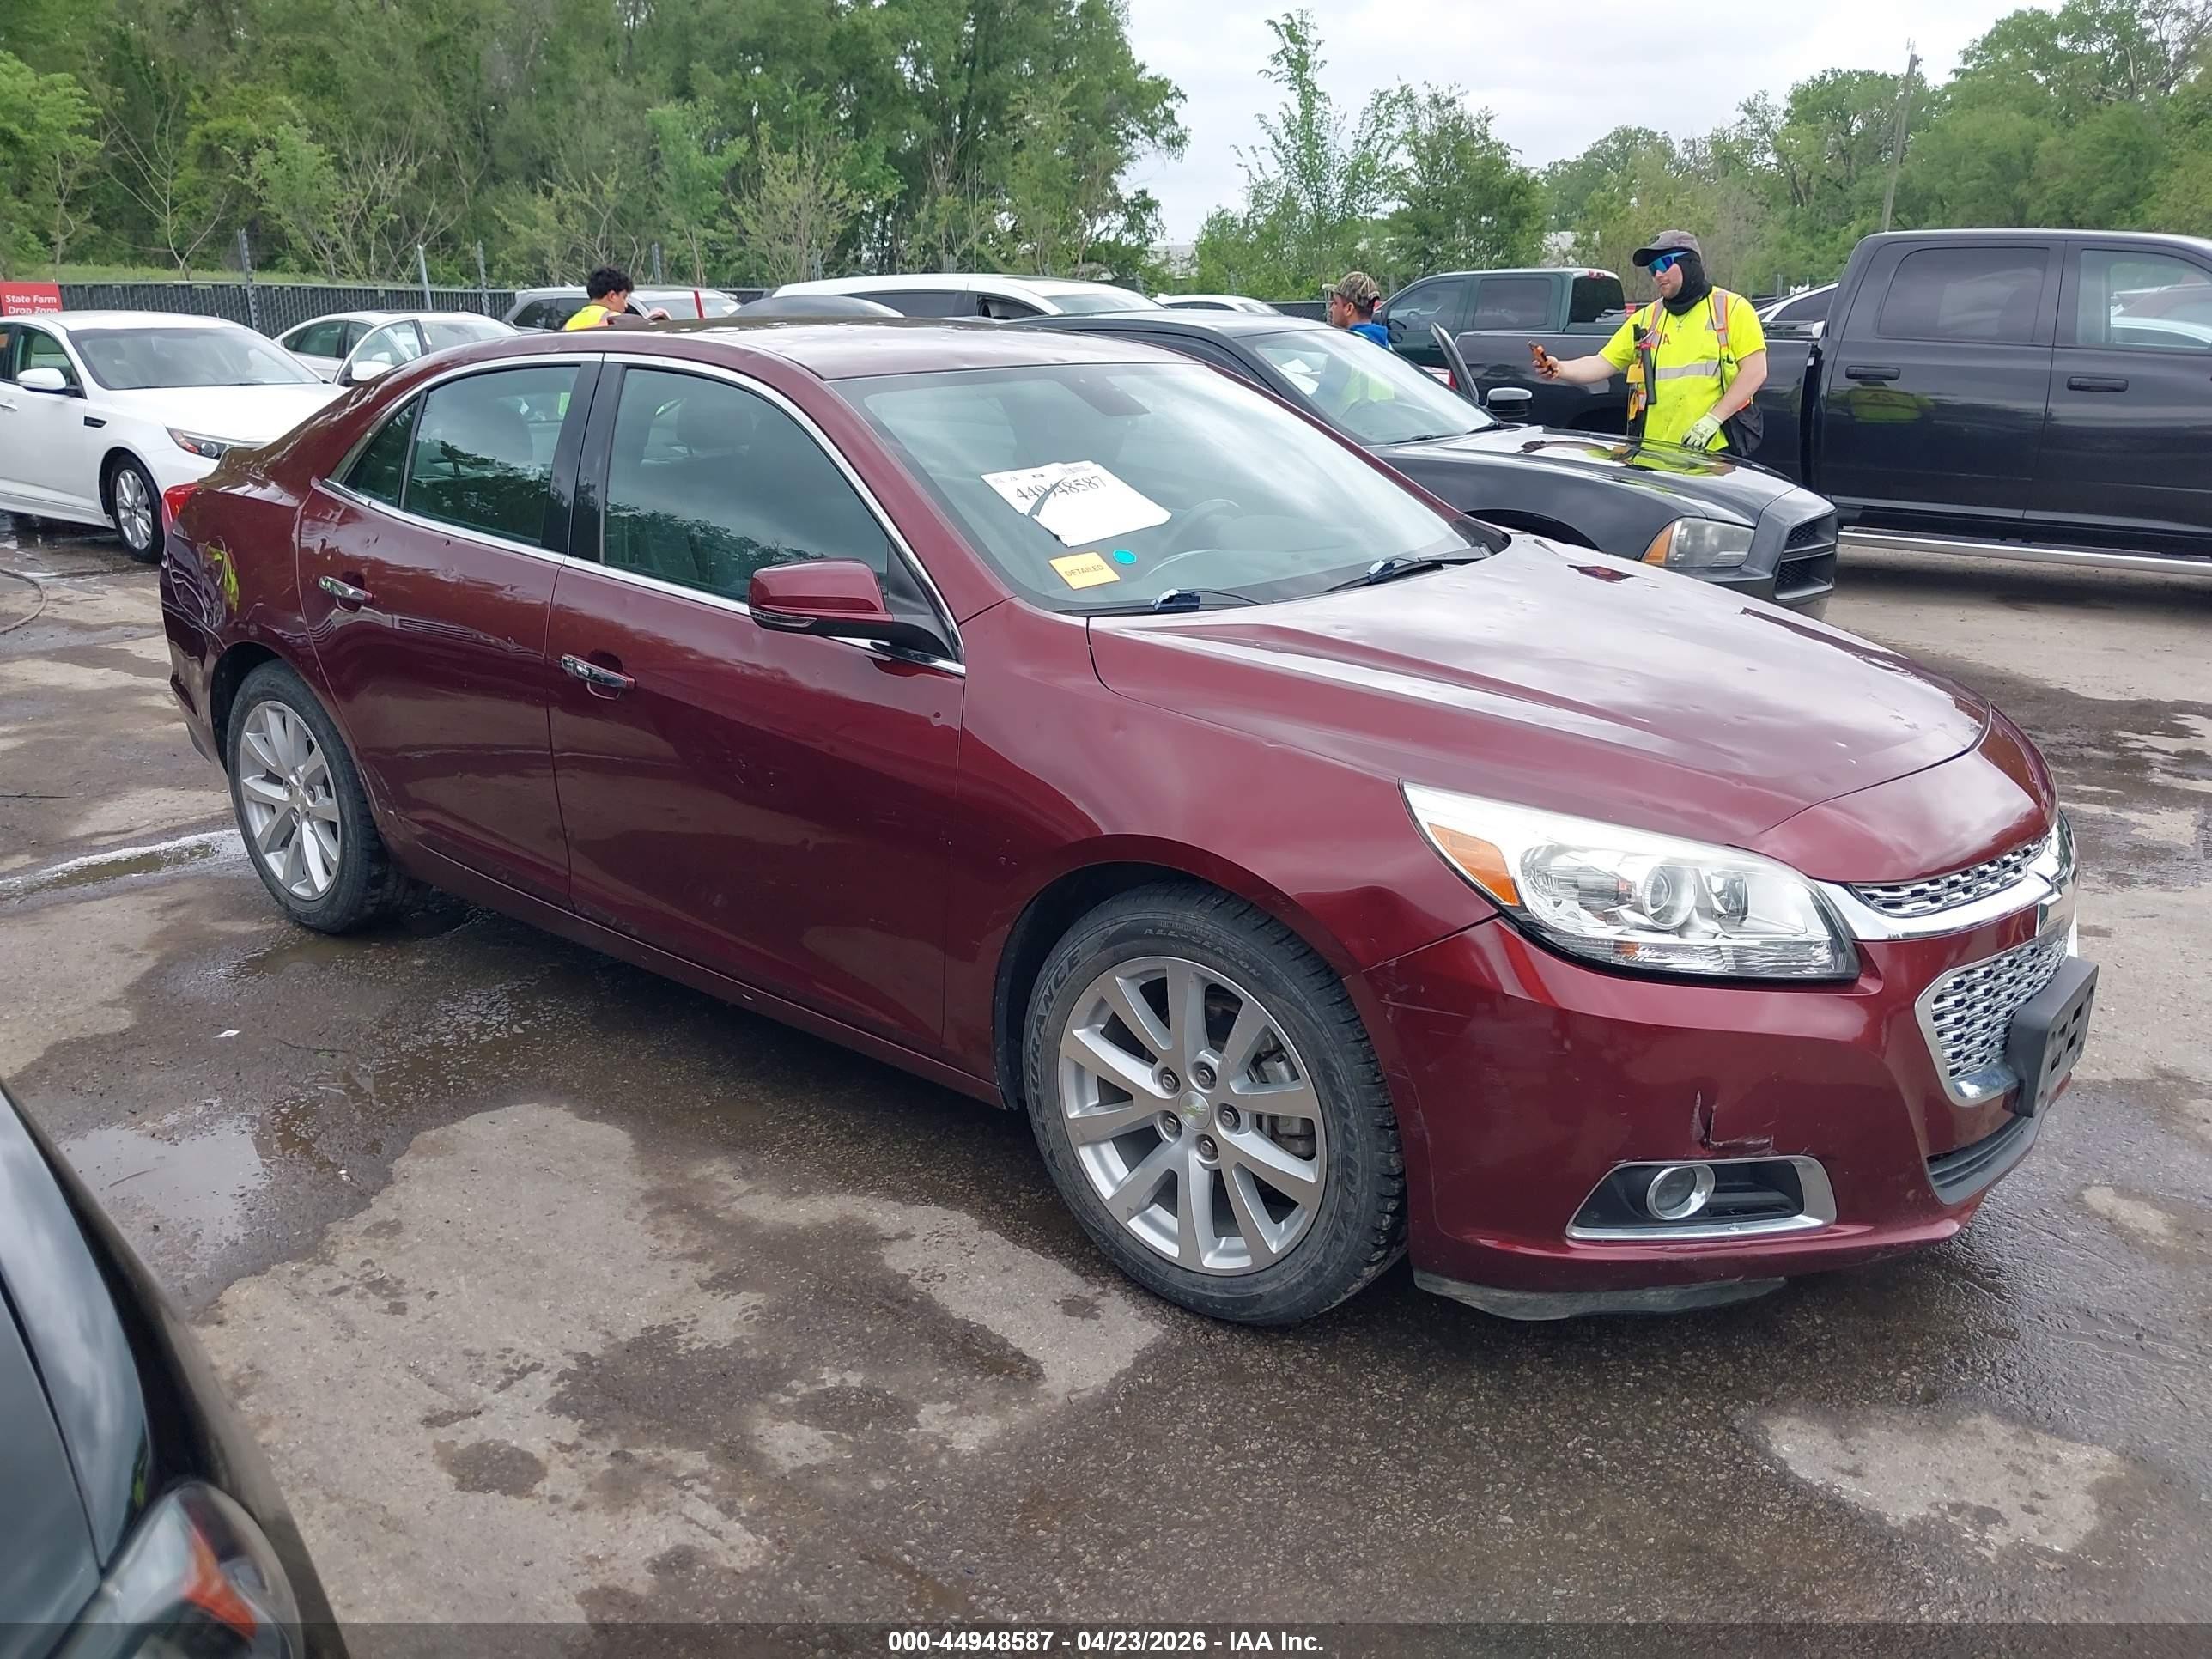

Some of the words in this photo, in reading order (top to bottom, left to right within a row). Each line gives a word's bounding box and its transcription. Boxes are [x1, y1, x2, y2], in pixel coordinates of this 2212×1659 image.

[6, 294, 31, 303] State
[33, 295, 57, 303] Farm
[9, 307, 33, 315] Drop
[1064, 563, 1104, 577] DETAILED
[1143, 927, 1262, 977] ALL-SEASON
